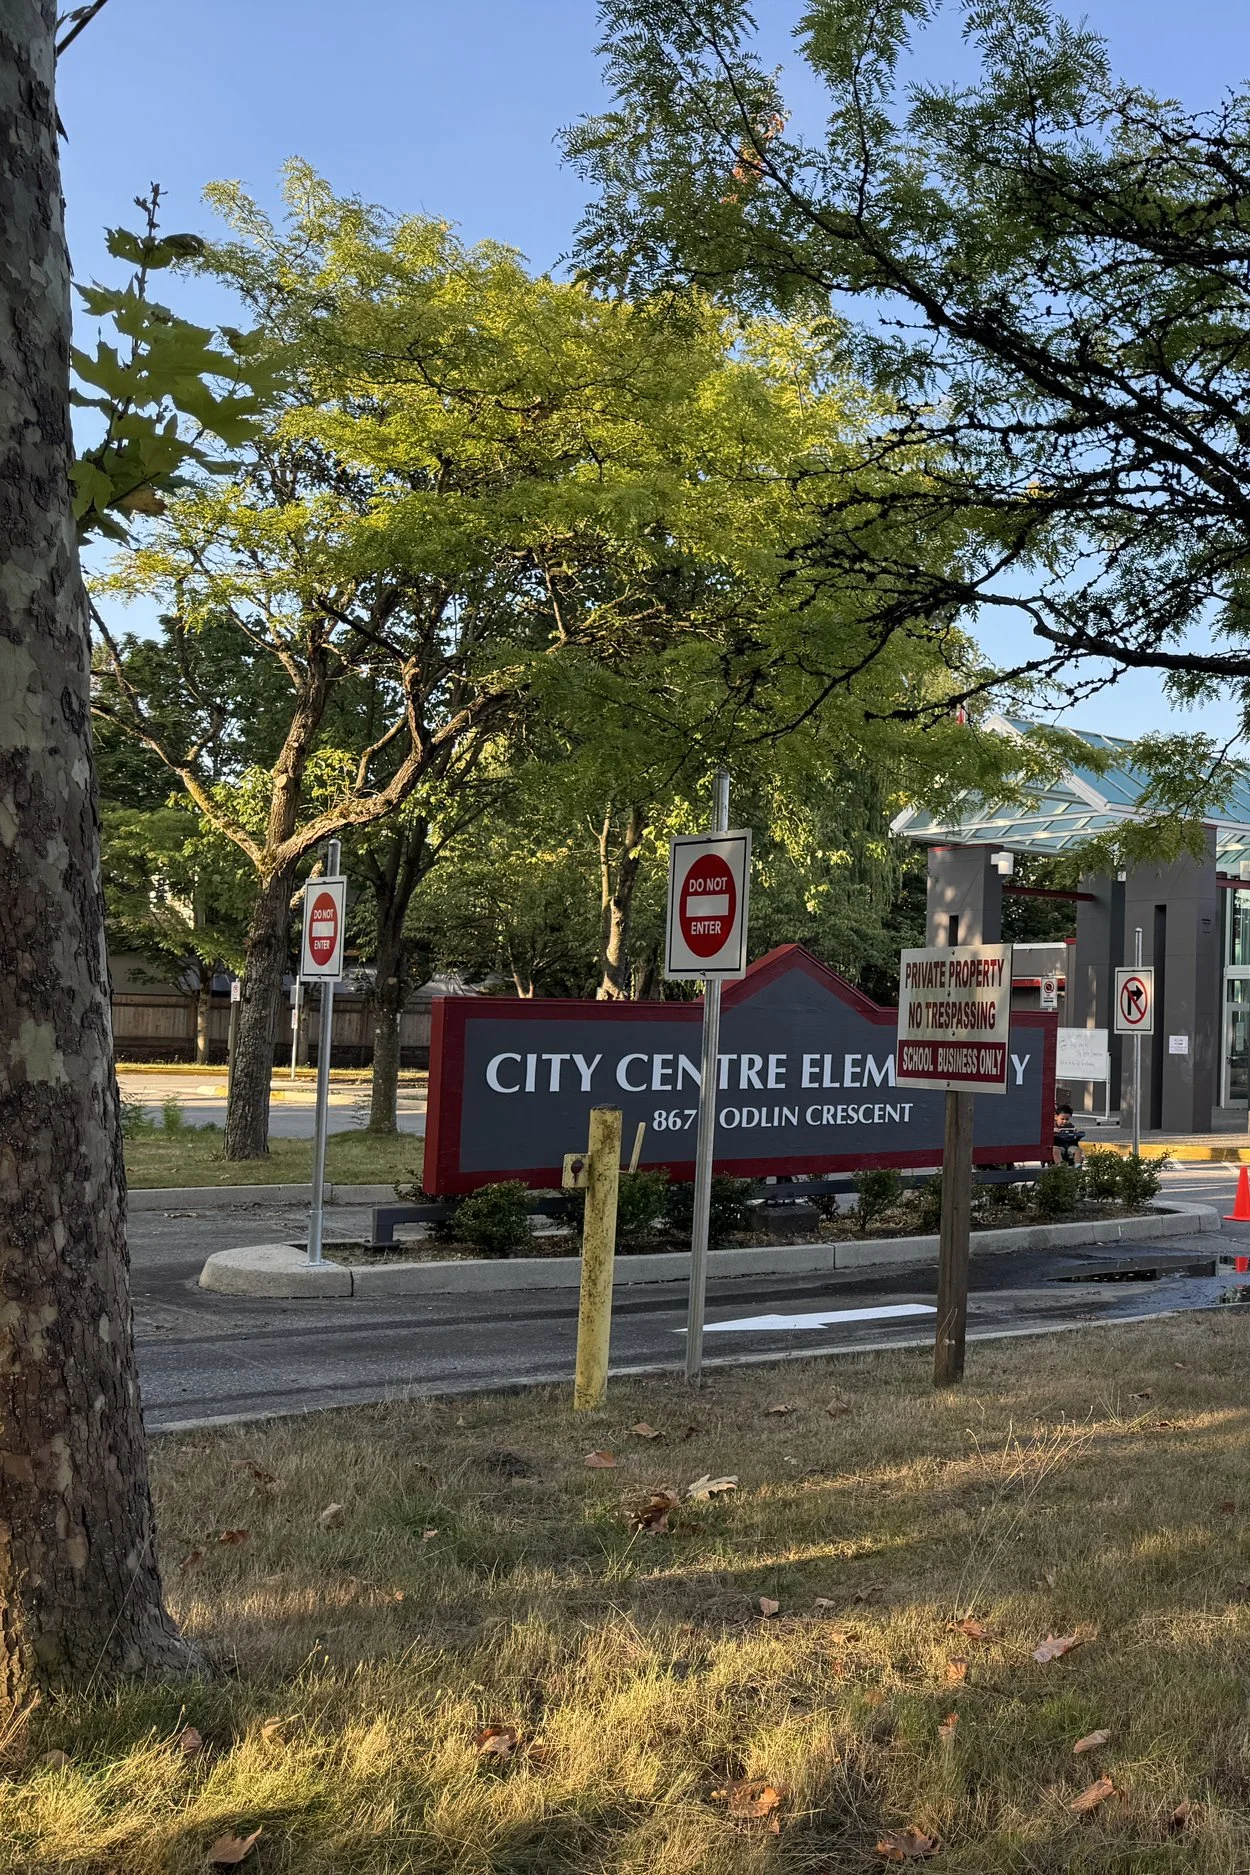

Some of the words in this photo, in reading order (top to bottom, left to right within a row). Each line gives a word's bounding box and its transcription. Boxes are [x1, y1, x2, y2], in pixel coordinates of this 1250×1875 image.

[689, 879, 704, 892] DO
[706, 877, 728, 891] NOT
[313, 909, 321, 919] DO
[322, 909, 334, 919] NOT
[691, 921, 721, 935] ENTER
[314, 940, 330, 950] ENTER
[905, 961, 946, 989] PRIVATE
[945, 958, 1005, 988] PROPERTY
[908, 1001, 923, 1029] NO
[925, 1001, 996, 1030] TRESPASSING
[486, 1052, 603, 1094] CITY
[801, 1053, 1031, 1089] ELEMY
[902, 1046, 934, 1072] SCHOOL
[937, 1047, 978, 1075] BUSINESS
[979, 1049, 1003, 1076] ONLY
[653, 1109, 700, 1131] 867
[719, 1106, 799, 1129] ODLIN
[805, 1103, 914, 1126] CRESCENT
